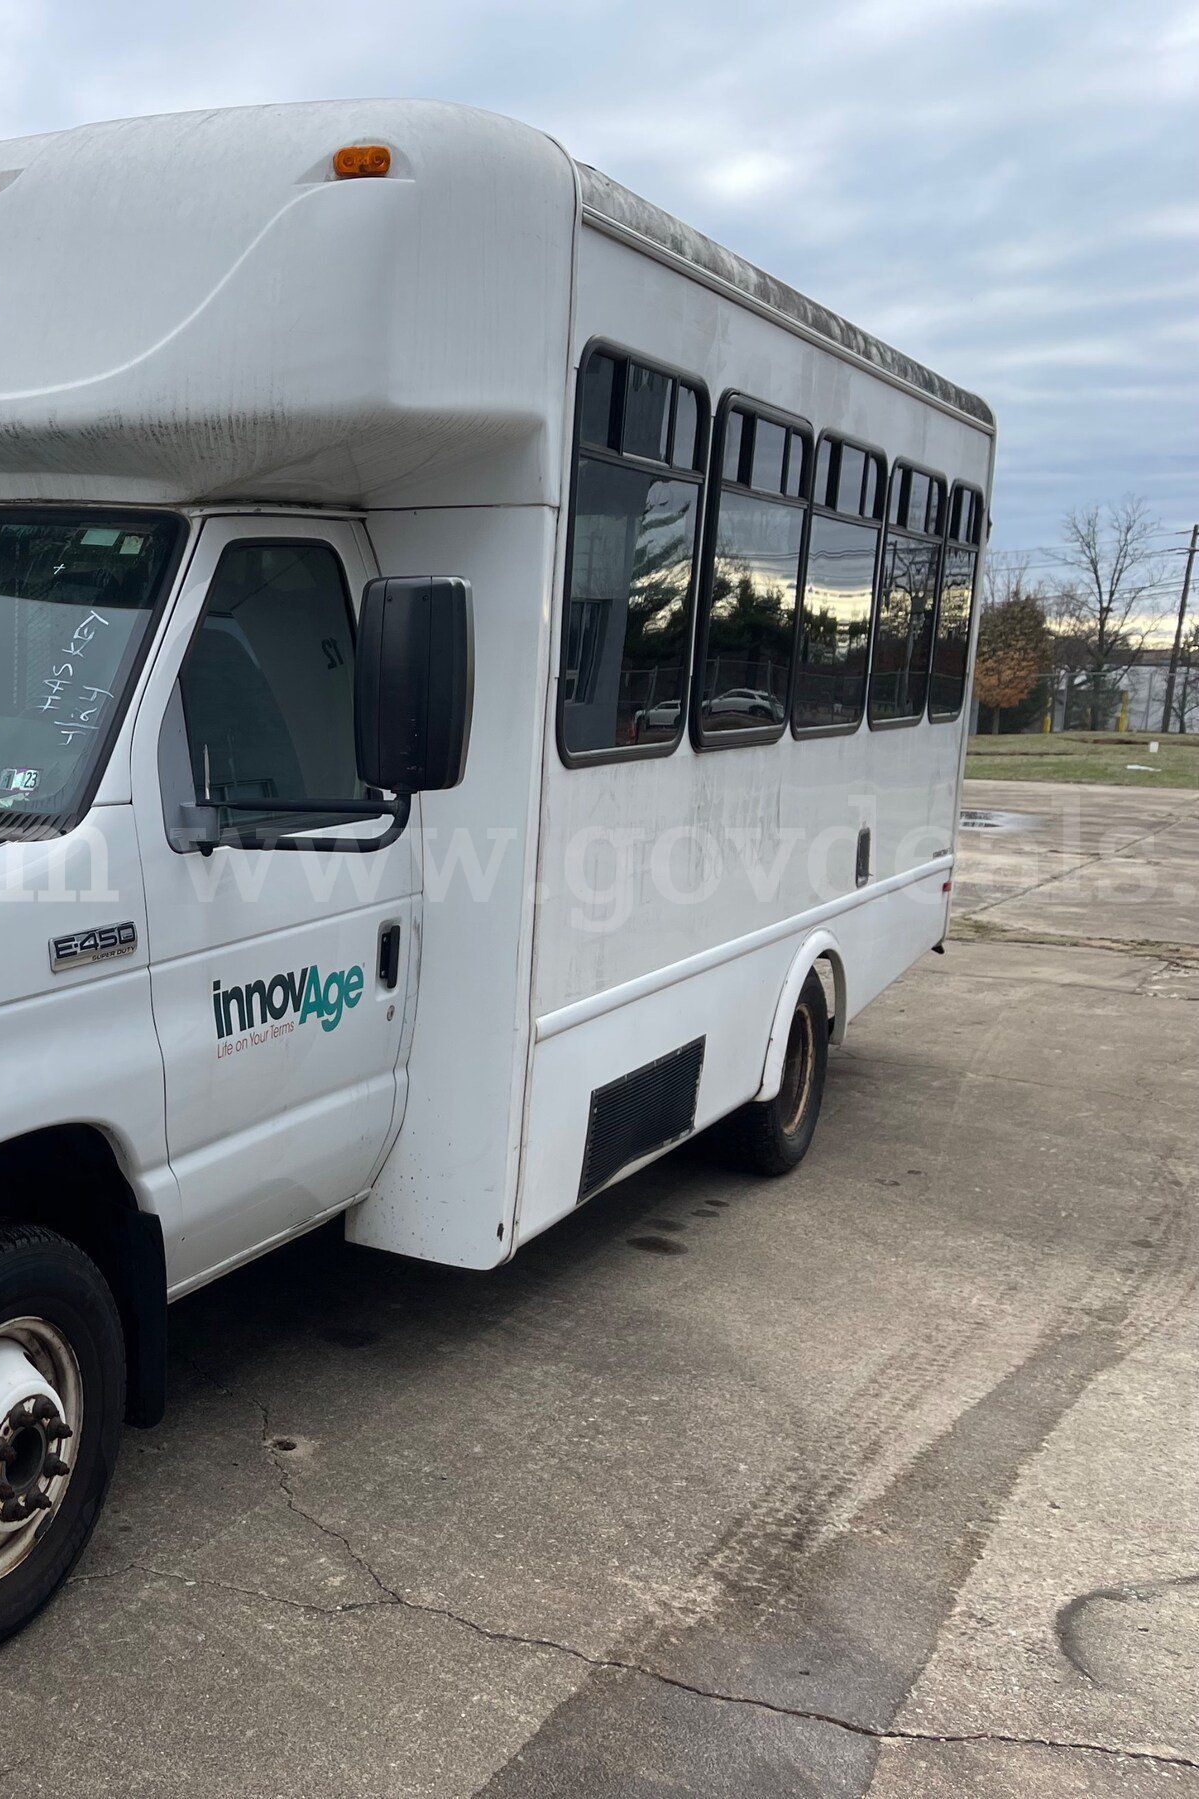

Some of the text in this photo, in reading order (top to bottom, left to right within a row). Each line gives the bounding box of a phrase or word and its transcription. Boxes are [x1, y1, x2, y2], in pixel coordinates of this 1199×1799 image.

[23, 771, 39, 788] 23
[91, 946, 135, 962] SUPER DUTY
[212, 965, 364, 1040] innovAge
[217, 1021, 295, 1059] Life on Your Terms
